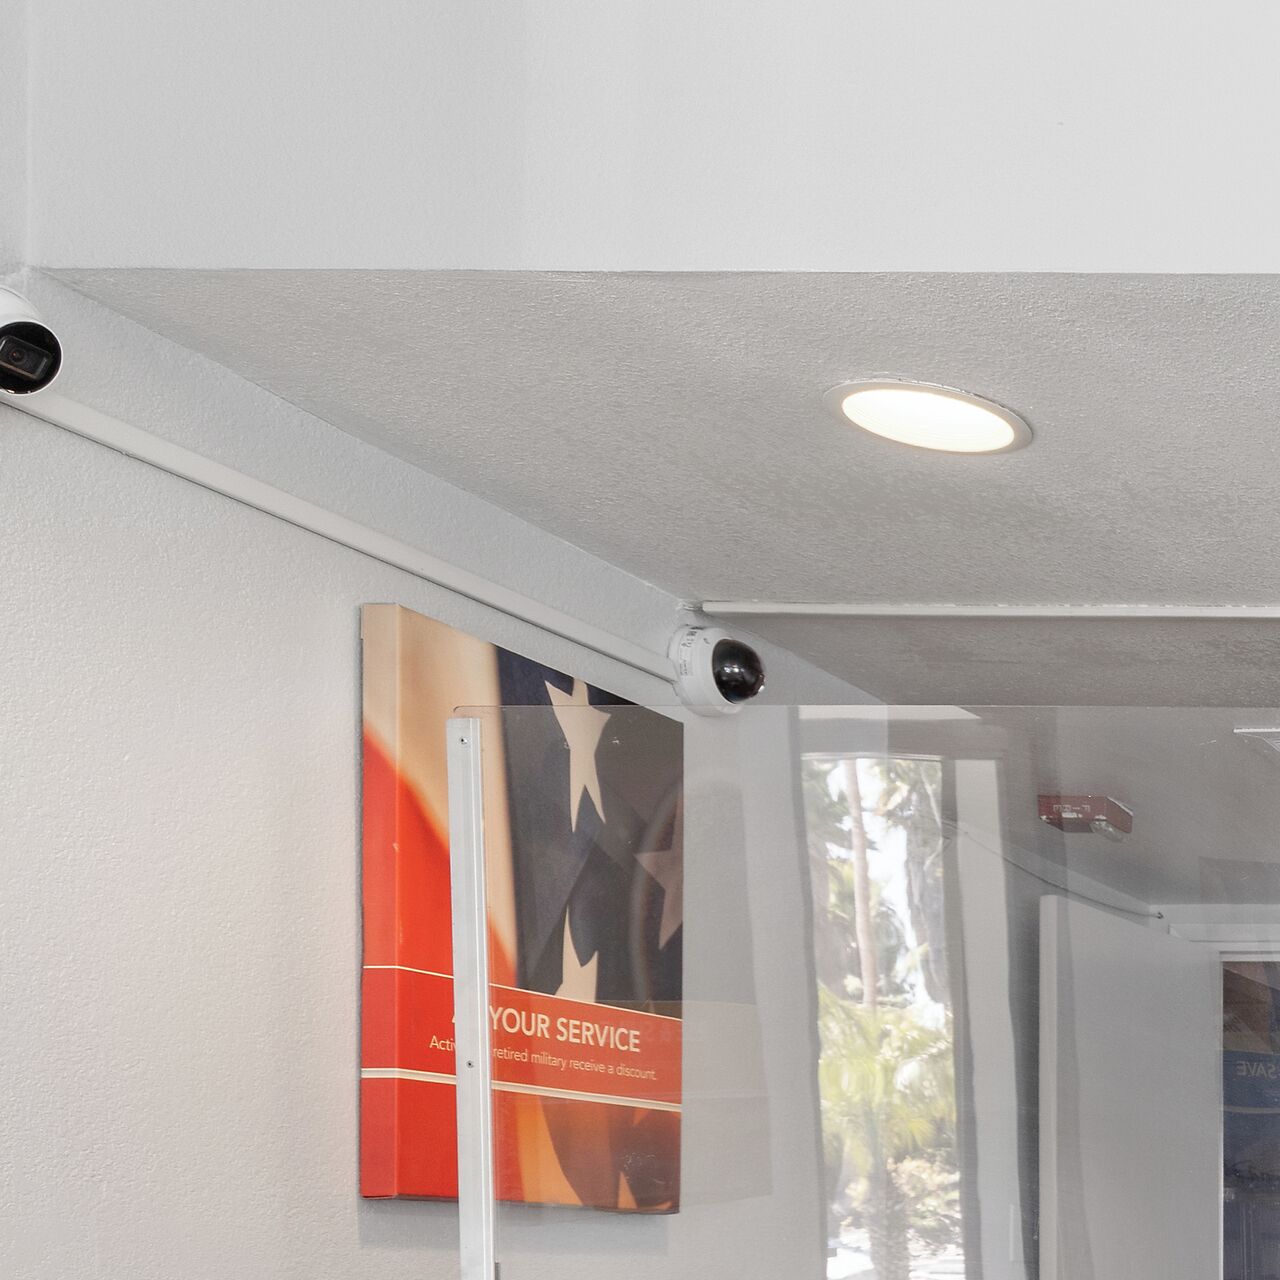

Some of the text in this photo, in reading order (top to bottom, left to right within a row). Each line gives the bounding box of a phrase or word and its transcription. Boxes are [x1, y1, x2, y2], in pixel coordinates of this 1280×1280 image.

[489, 1005, 641, 1053] YOUR SERVICE
[492, 1046, 528, 1062] retired
[530, 1051, 567, 1071] military
[569, 1059, 605, 1073] receive
[615, 1064, 657, 1081] discount.
